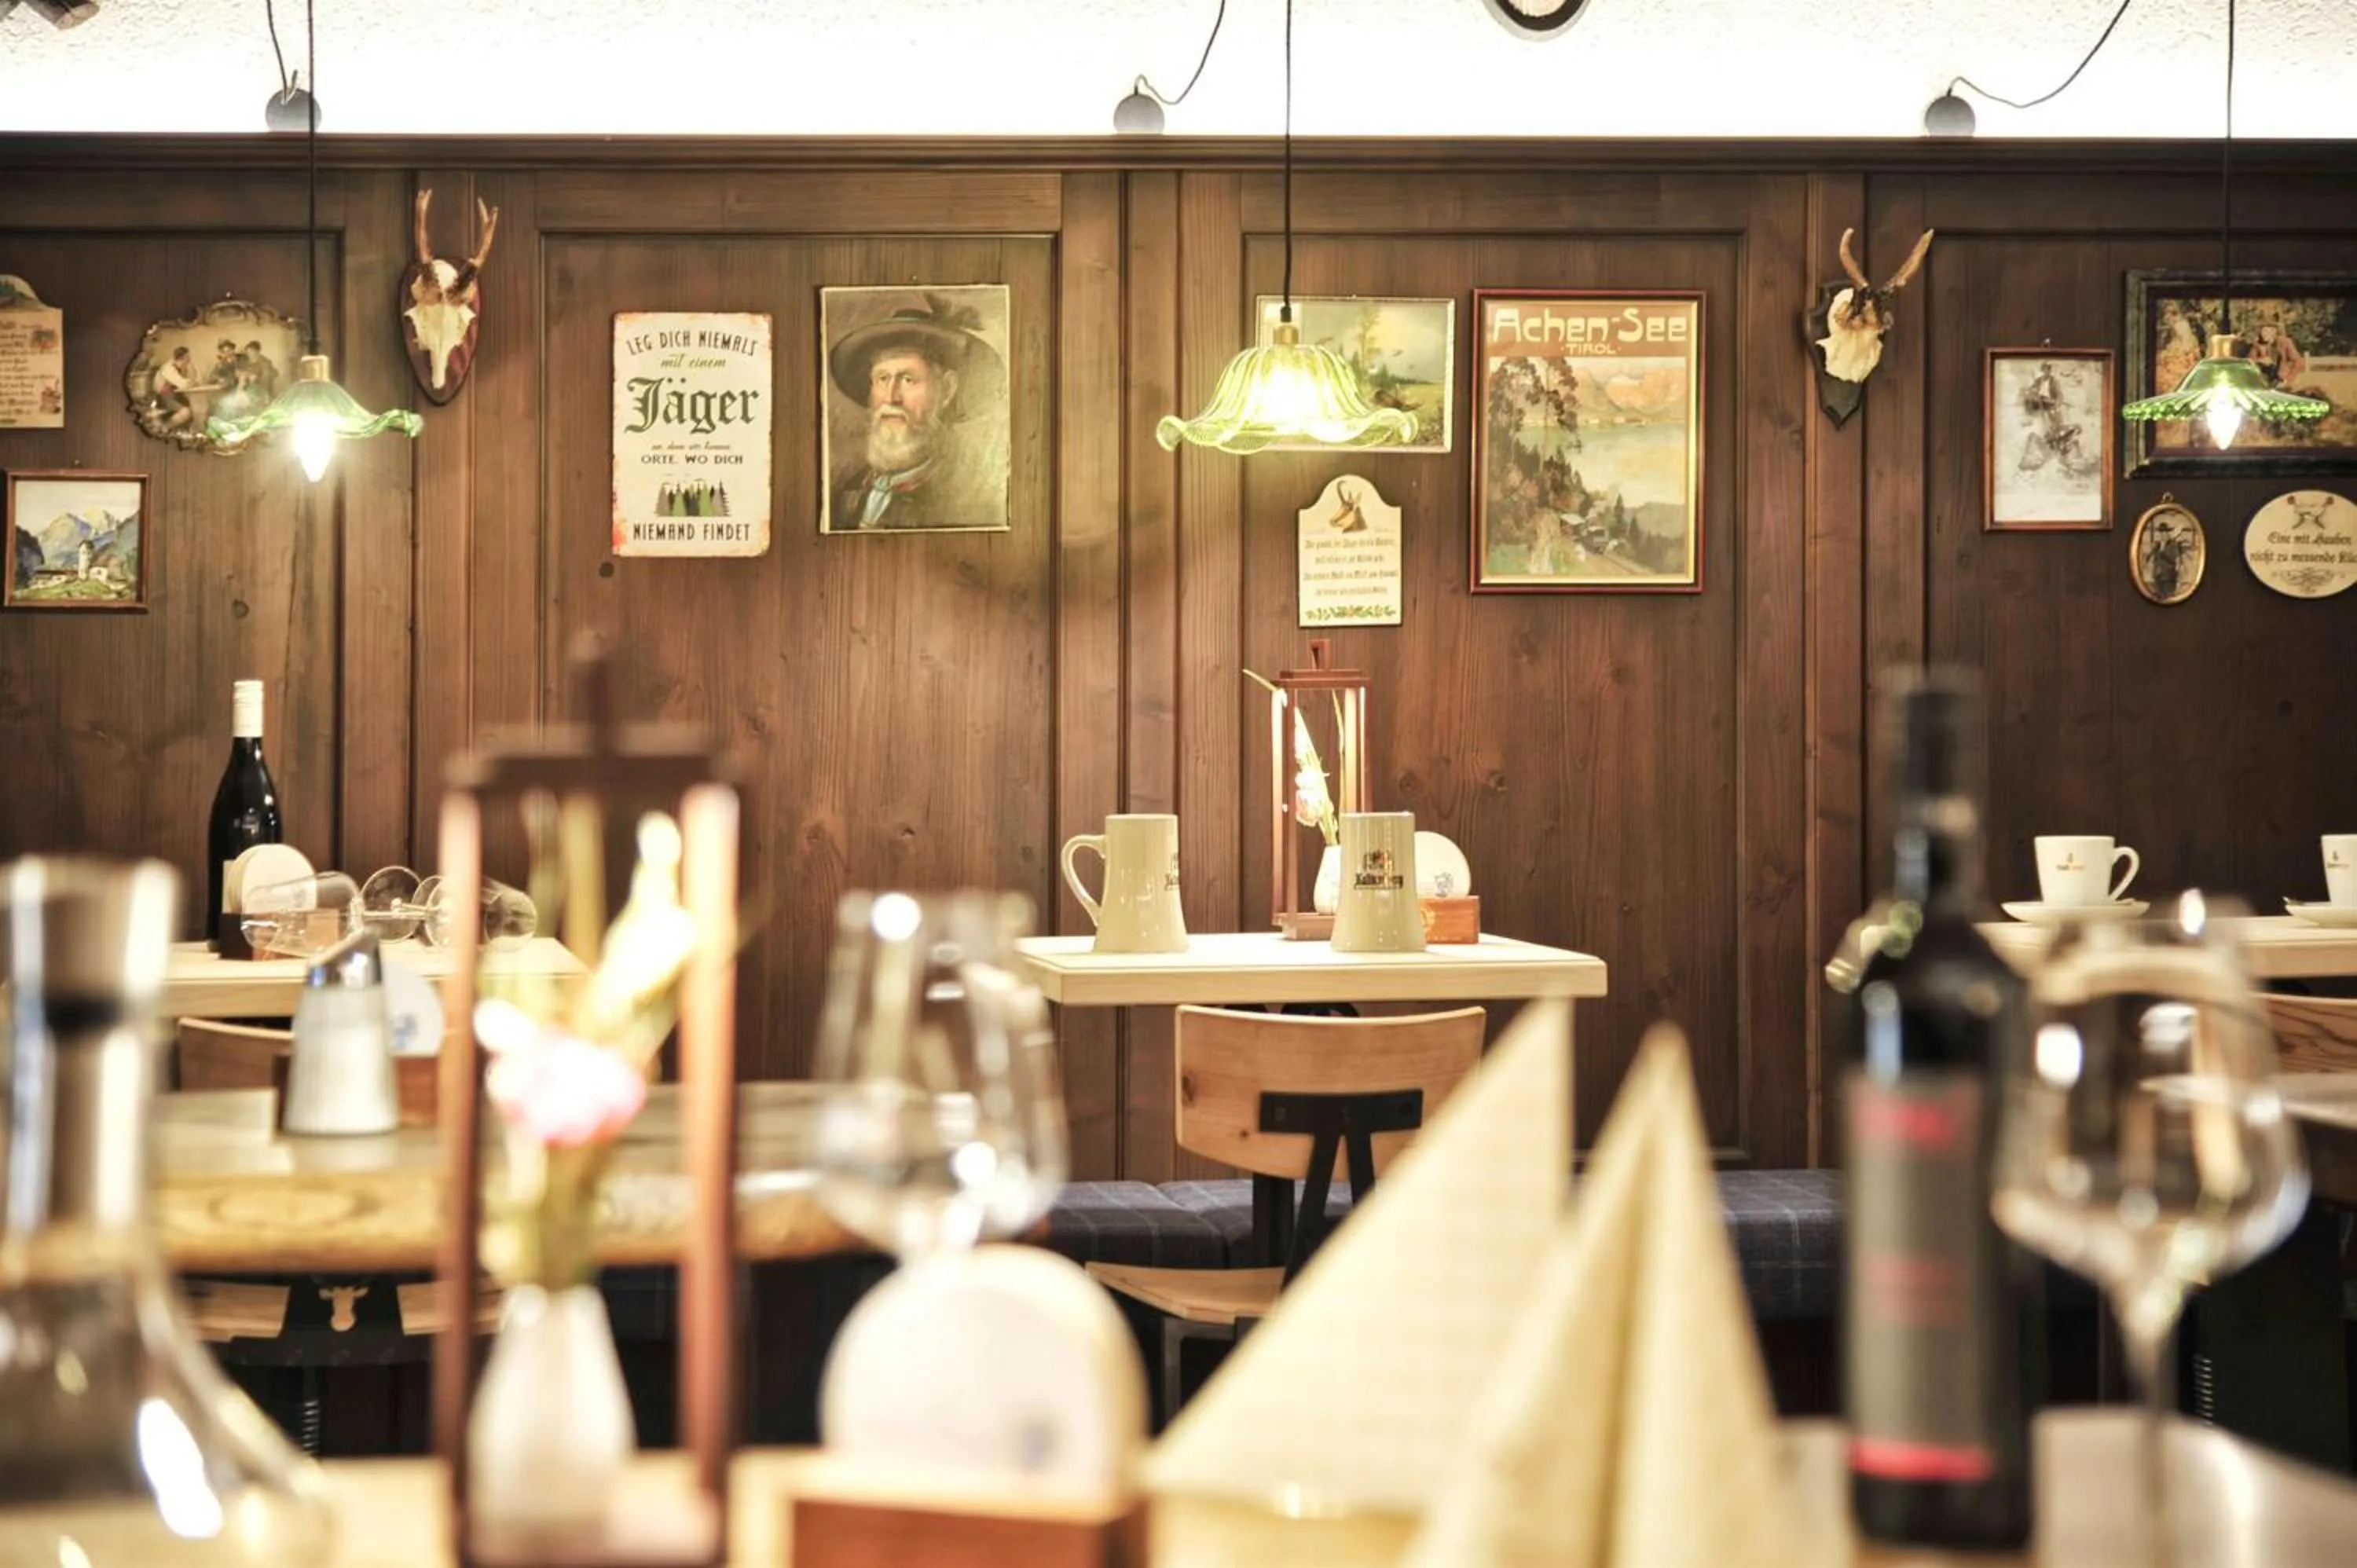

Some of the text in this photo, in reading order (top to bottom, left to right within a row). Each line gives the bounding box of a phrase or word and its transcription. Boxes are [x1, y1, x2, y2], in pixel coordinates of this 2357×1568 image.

[1493, 307, 1687, 343] Achen-See
[626, 330, 758, 357] LEG DICH NIEMALS
[1566, 343, 1617, 355] TIROL
[660, 353, 727, 368] mit einem
[624, 376, 760, 434] Jäger
[640, 454, 743, 464] ORTE WO DICH
[633, 523, 750, 541] NIEMAND FINDET
[2293, 533, 2311, 544] mit
